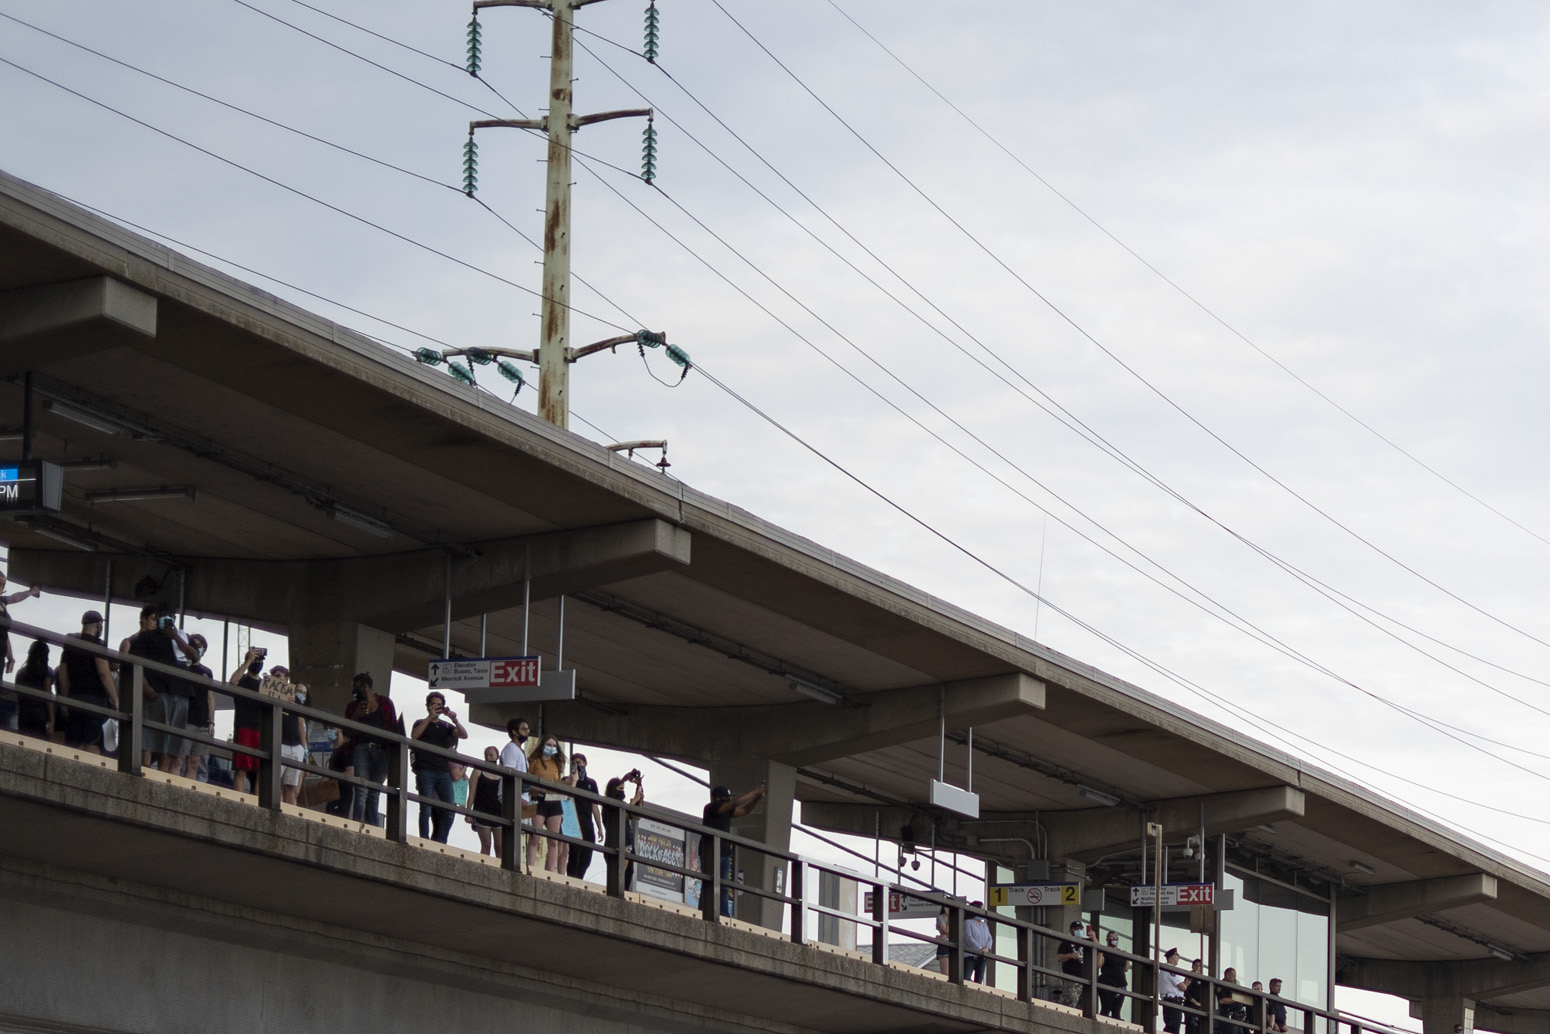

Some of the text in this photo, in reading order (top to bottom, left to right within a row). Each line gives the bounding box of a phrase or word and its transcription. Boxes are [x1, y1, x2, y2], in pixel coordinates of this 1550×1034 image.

[490, 661, 536, 683] Exit
[865, 894, 897, 910] Et
[994, 887, 1002, 902] 1
[1065, 886, 1076, 901] 2
[1177, 886, 1211, 902] Exit
